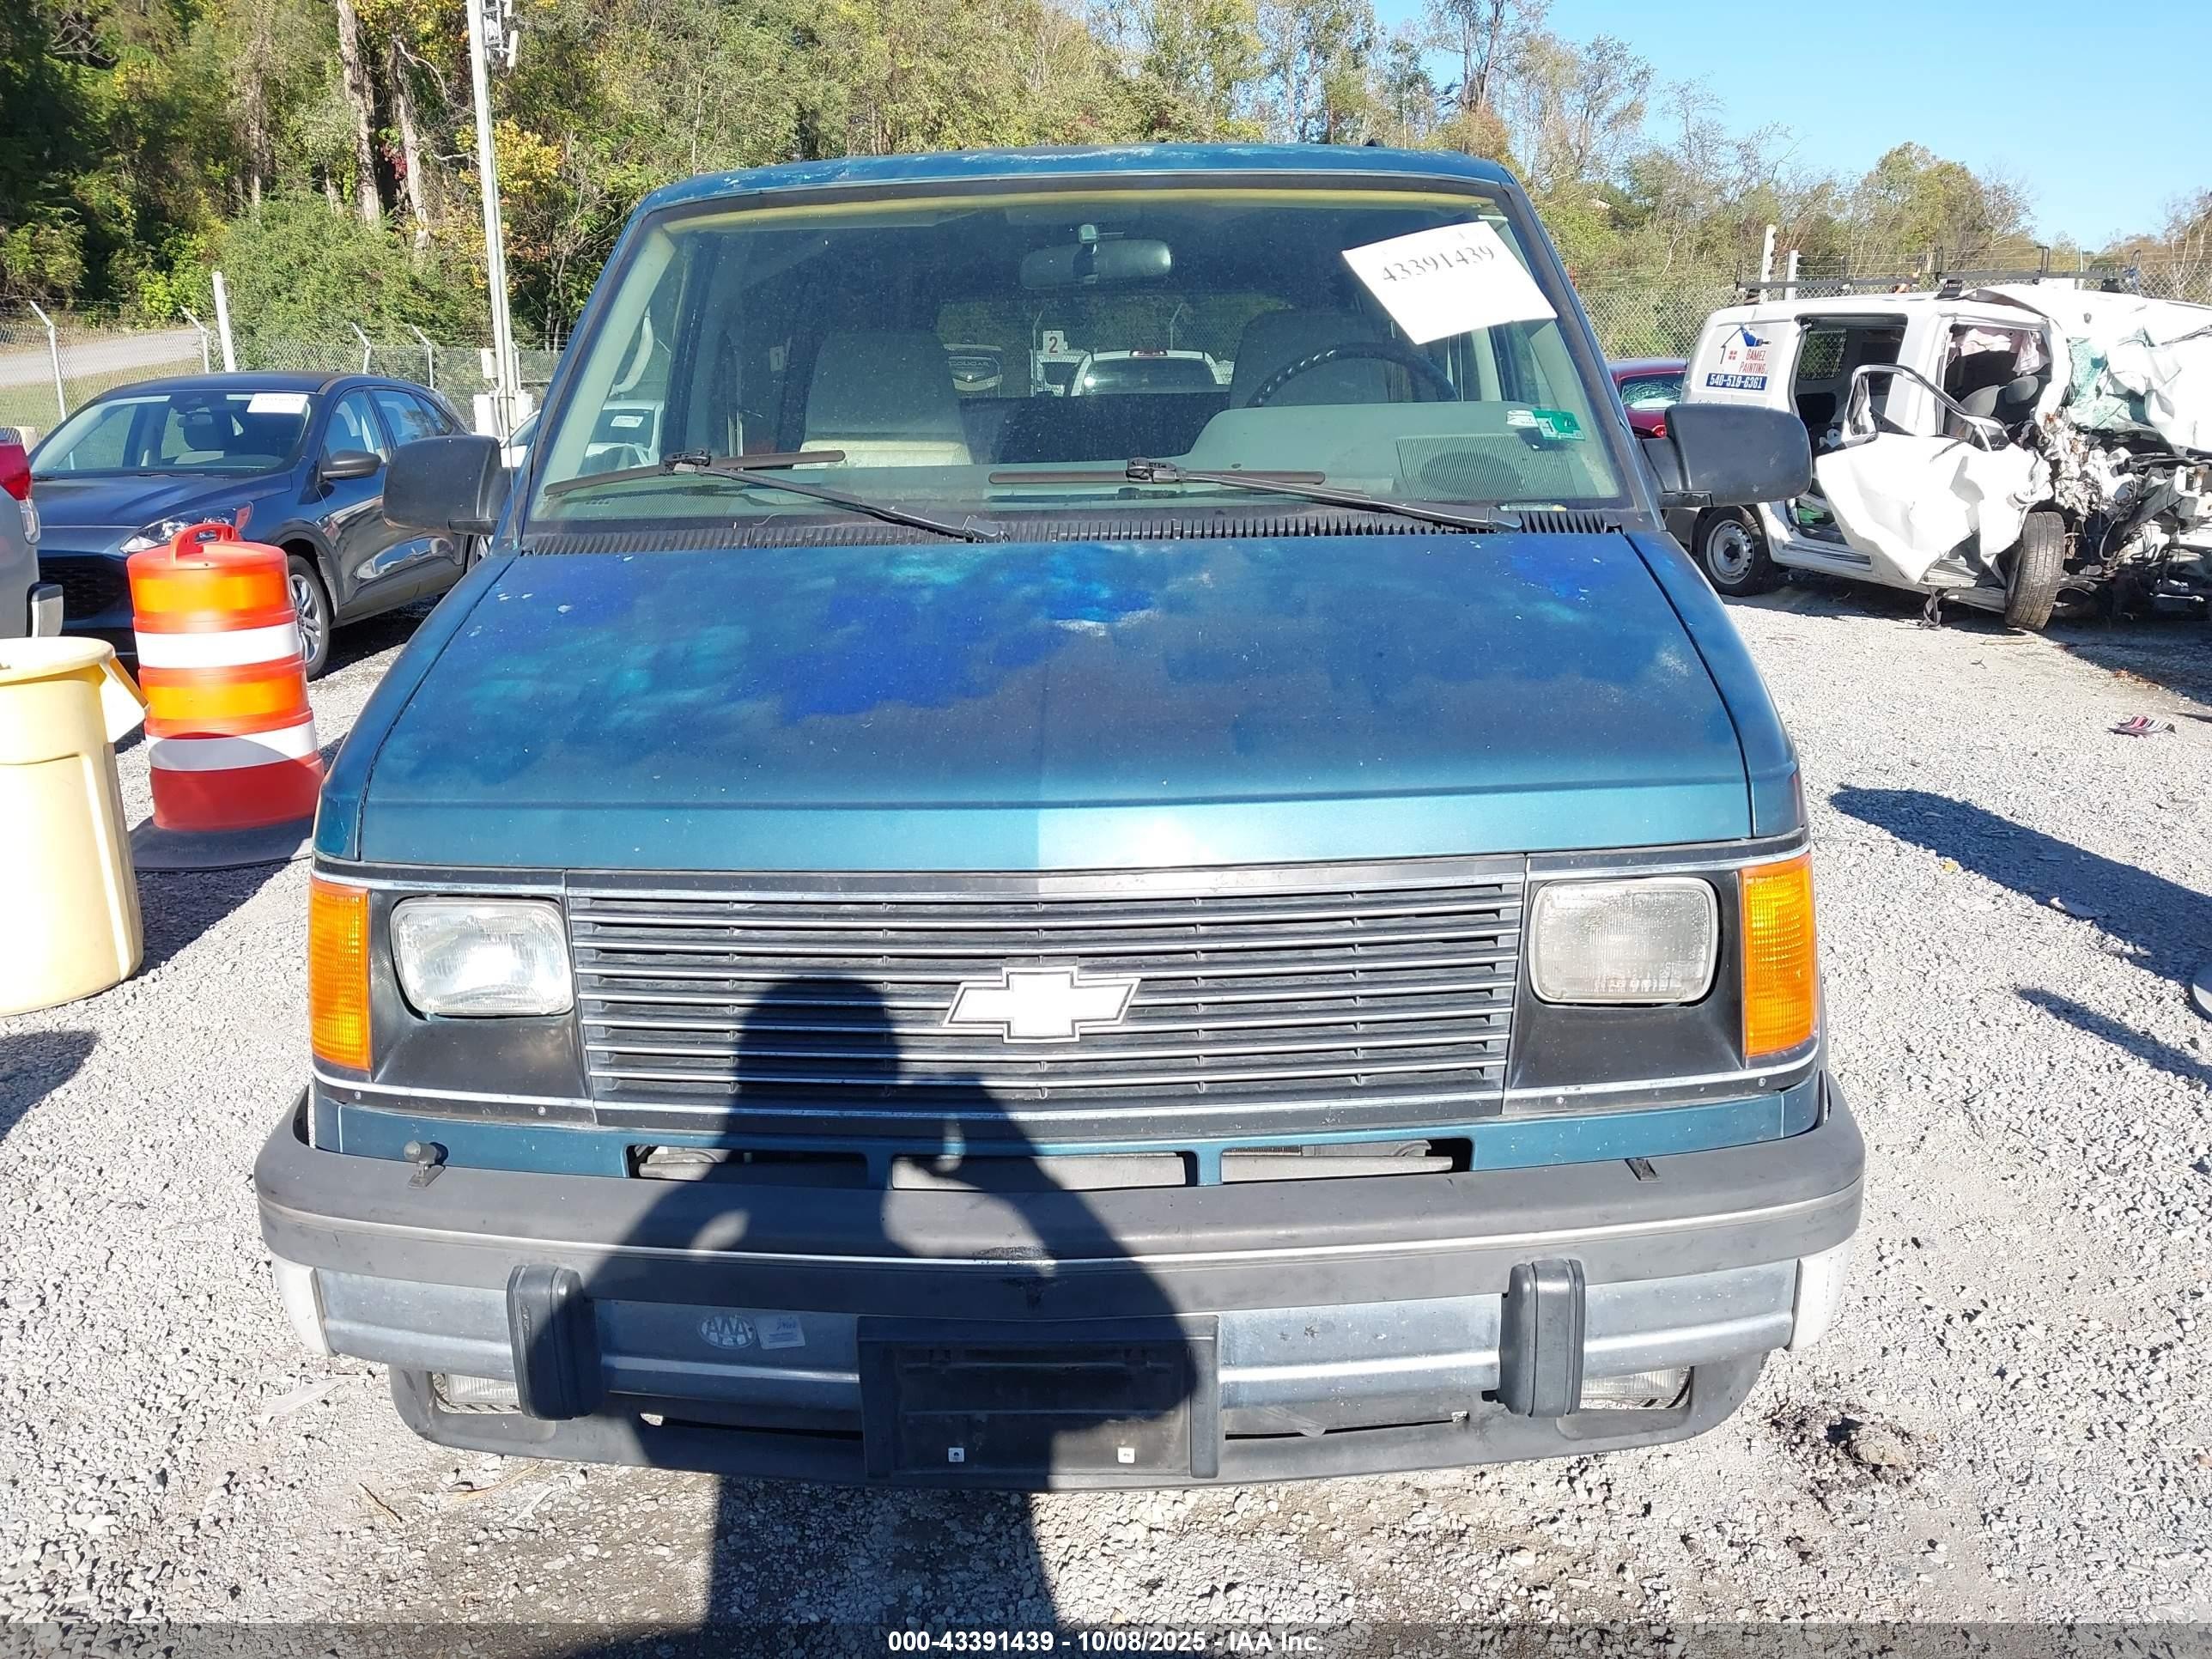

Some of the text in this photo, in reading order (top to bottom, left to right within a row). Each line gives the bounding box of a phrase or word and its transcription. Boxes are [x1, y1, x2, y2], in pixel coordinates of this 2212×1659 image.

[1382, 245, 1495, 282] 43391439
[1048, 336, 1059, 354] 2
[1746, 349, 1766, 361] GAMEZ
[1739, 361, 1766, 374] PAINTING
